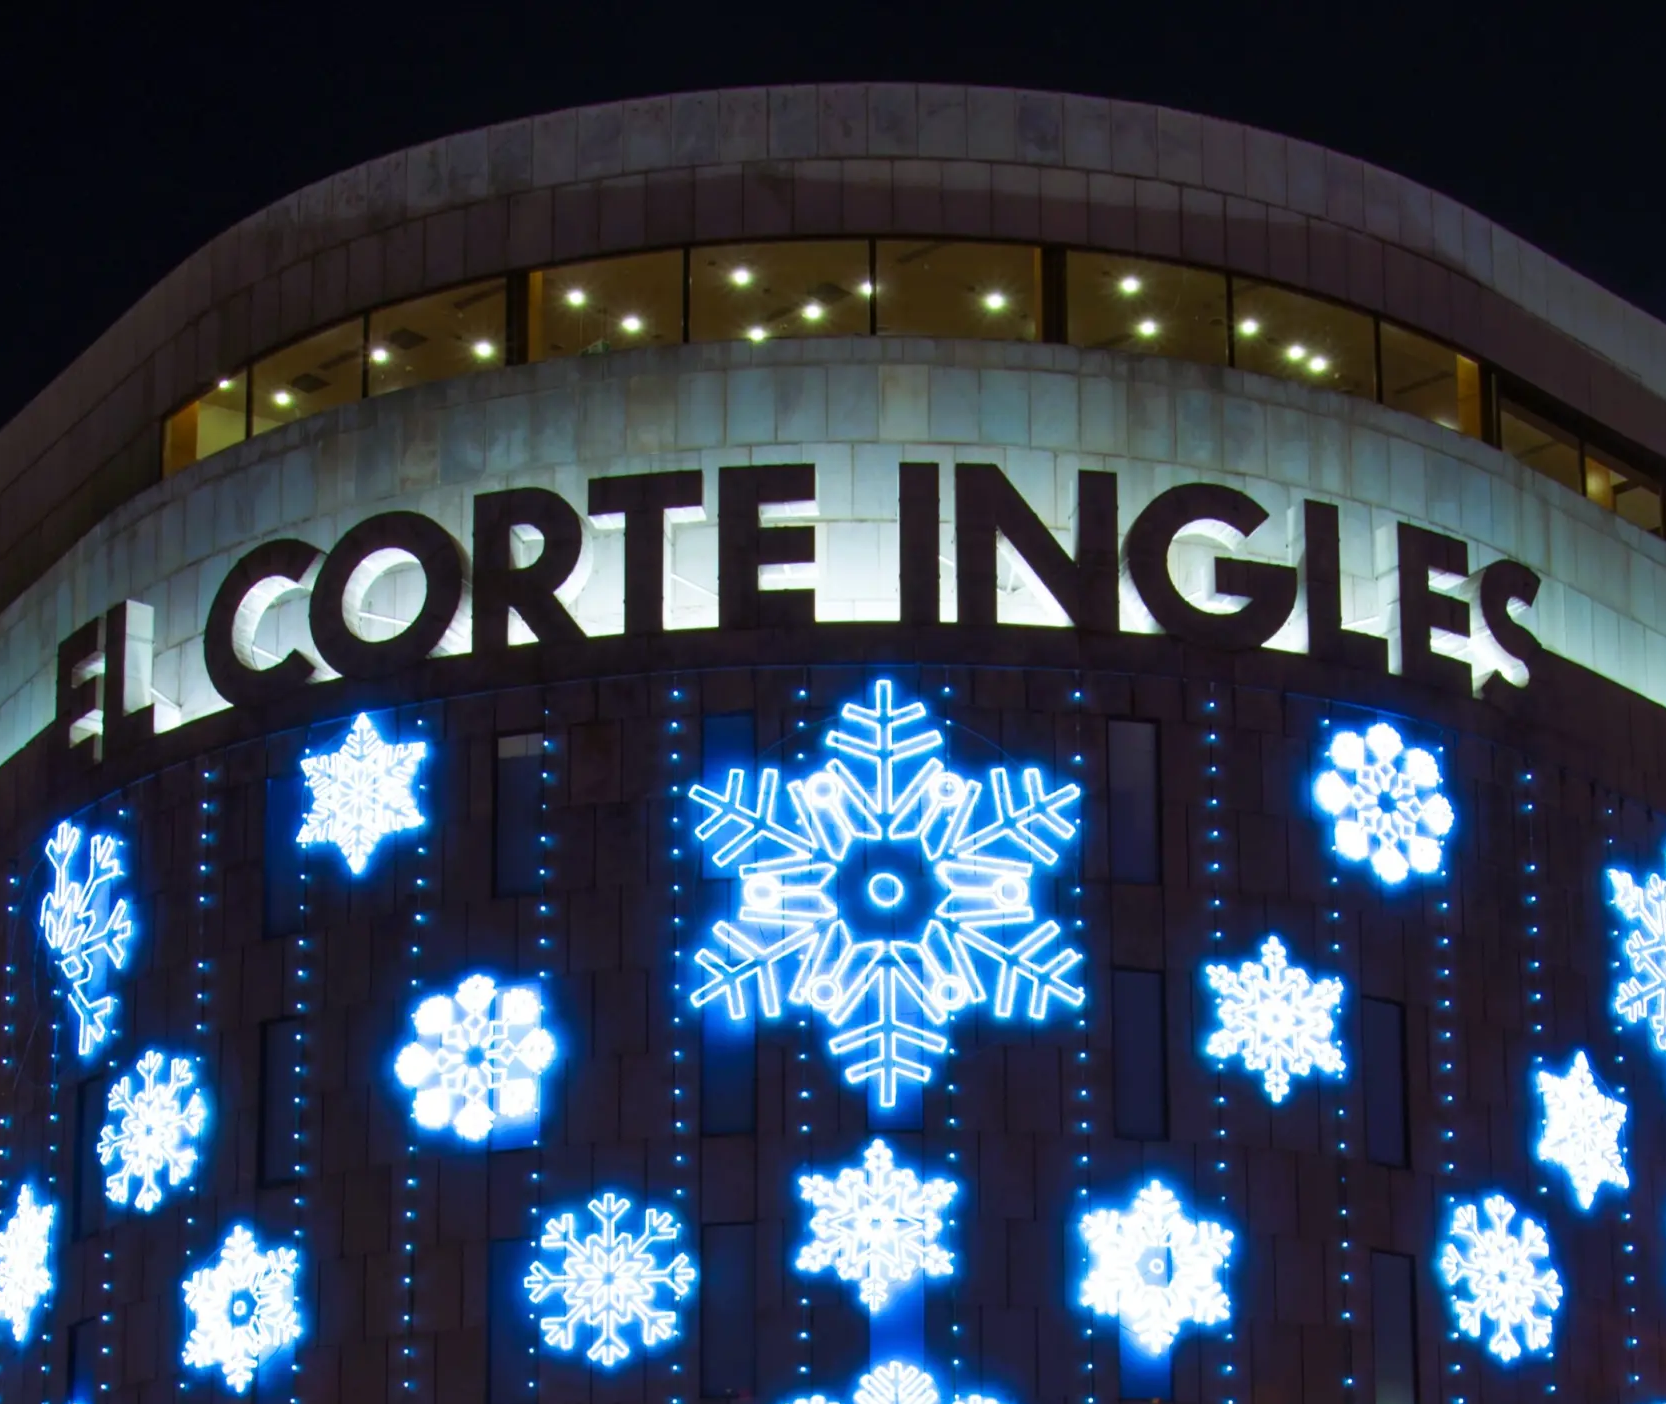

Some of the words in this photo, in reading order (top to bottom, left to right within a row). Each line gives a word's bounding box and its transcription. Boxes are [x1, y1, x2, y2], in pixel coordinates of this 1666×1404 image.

[55, 598, 159, 768] EL
[203, 462, 817, 710] CORTE
[899, 461, 1542, 700] INGLES
